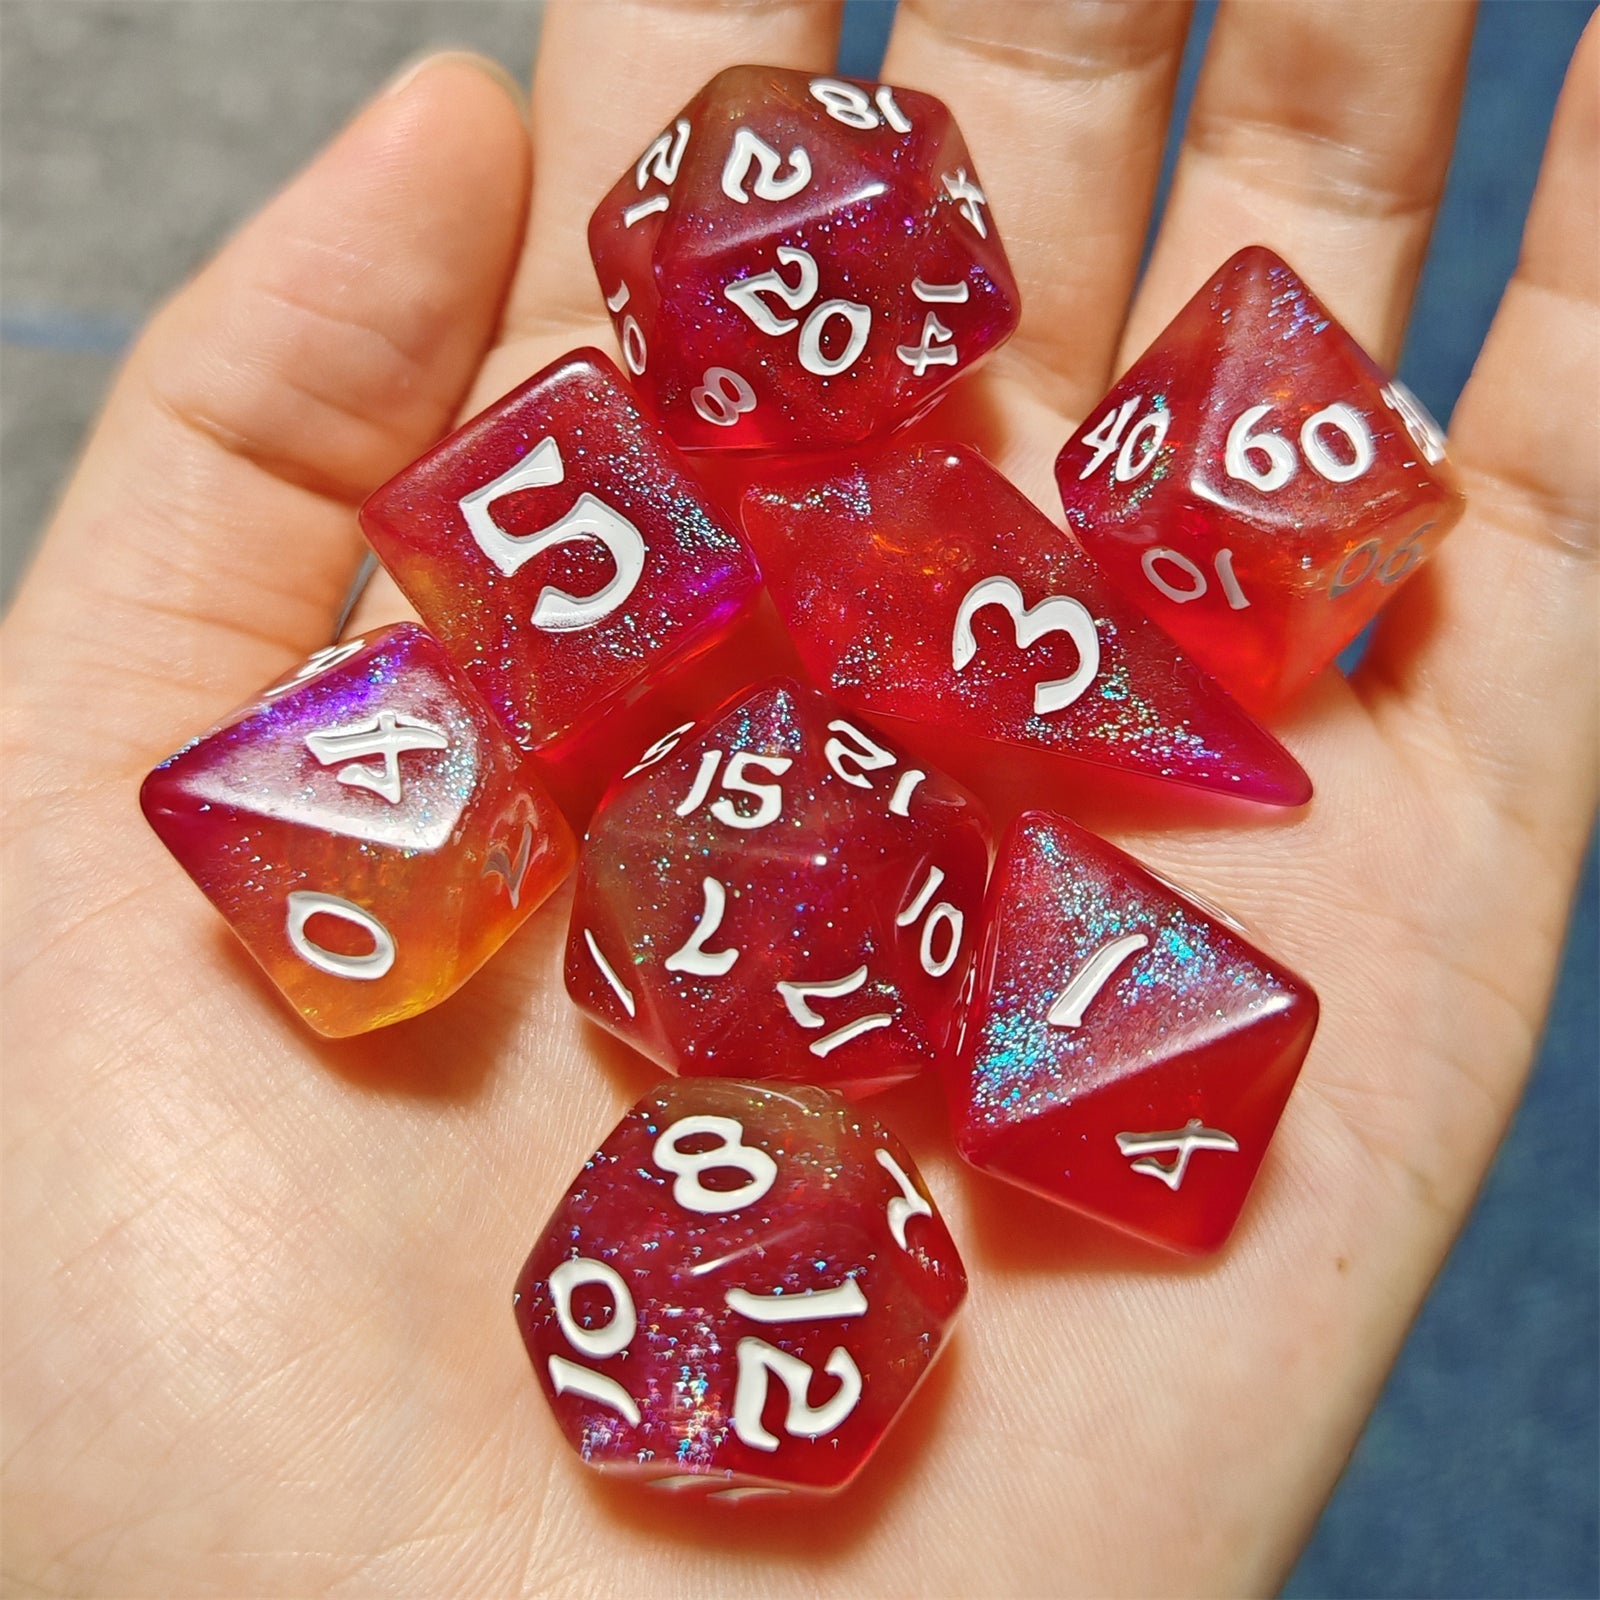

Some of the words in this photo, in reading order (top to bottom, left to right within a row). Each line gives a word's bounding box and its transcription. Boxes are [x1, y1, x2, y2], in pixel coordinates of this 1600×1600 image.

[809, 77, 913, 134] 18
[623, 118, 691, 229] 12
[721, 126, 812, 204] 2
[940, 166, 988, 240] 4
[724, 246, 873, 376] 20
[896, 276, 970, 377] 14
[689, 366, 758, 427] 8
[1078, 394, 1171, 483] 40
[1224, 401, 1376, 493] 60
[458, 436, 645, 634] 5
[1141, 547, 1252, 611] 10
[952, 574, 1101, 716] 3
[303, 709, 450, 806] 4
[675, 748, 793, 830] 15
[823, 718, 927, 817] 12
[285, 889, 397, 981] 0
[664, 876, 740, 977] 7
[894, 864, 965, 977] 10
[776, 964, 893, 1059] 17
[1046, 932, 1149, 1029] 1
[652, 1114, 779, 1214] 8
[1114, 1117, 1241, 1193] 4
[548, 1256, 642, 1429] 10
[723, 1277, 870, 1453] 12
